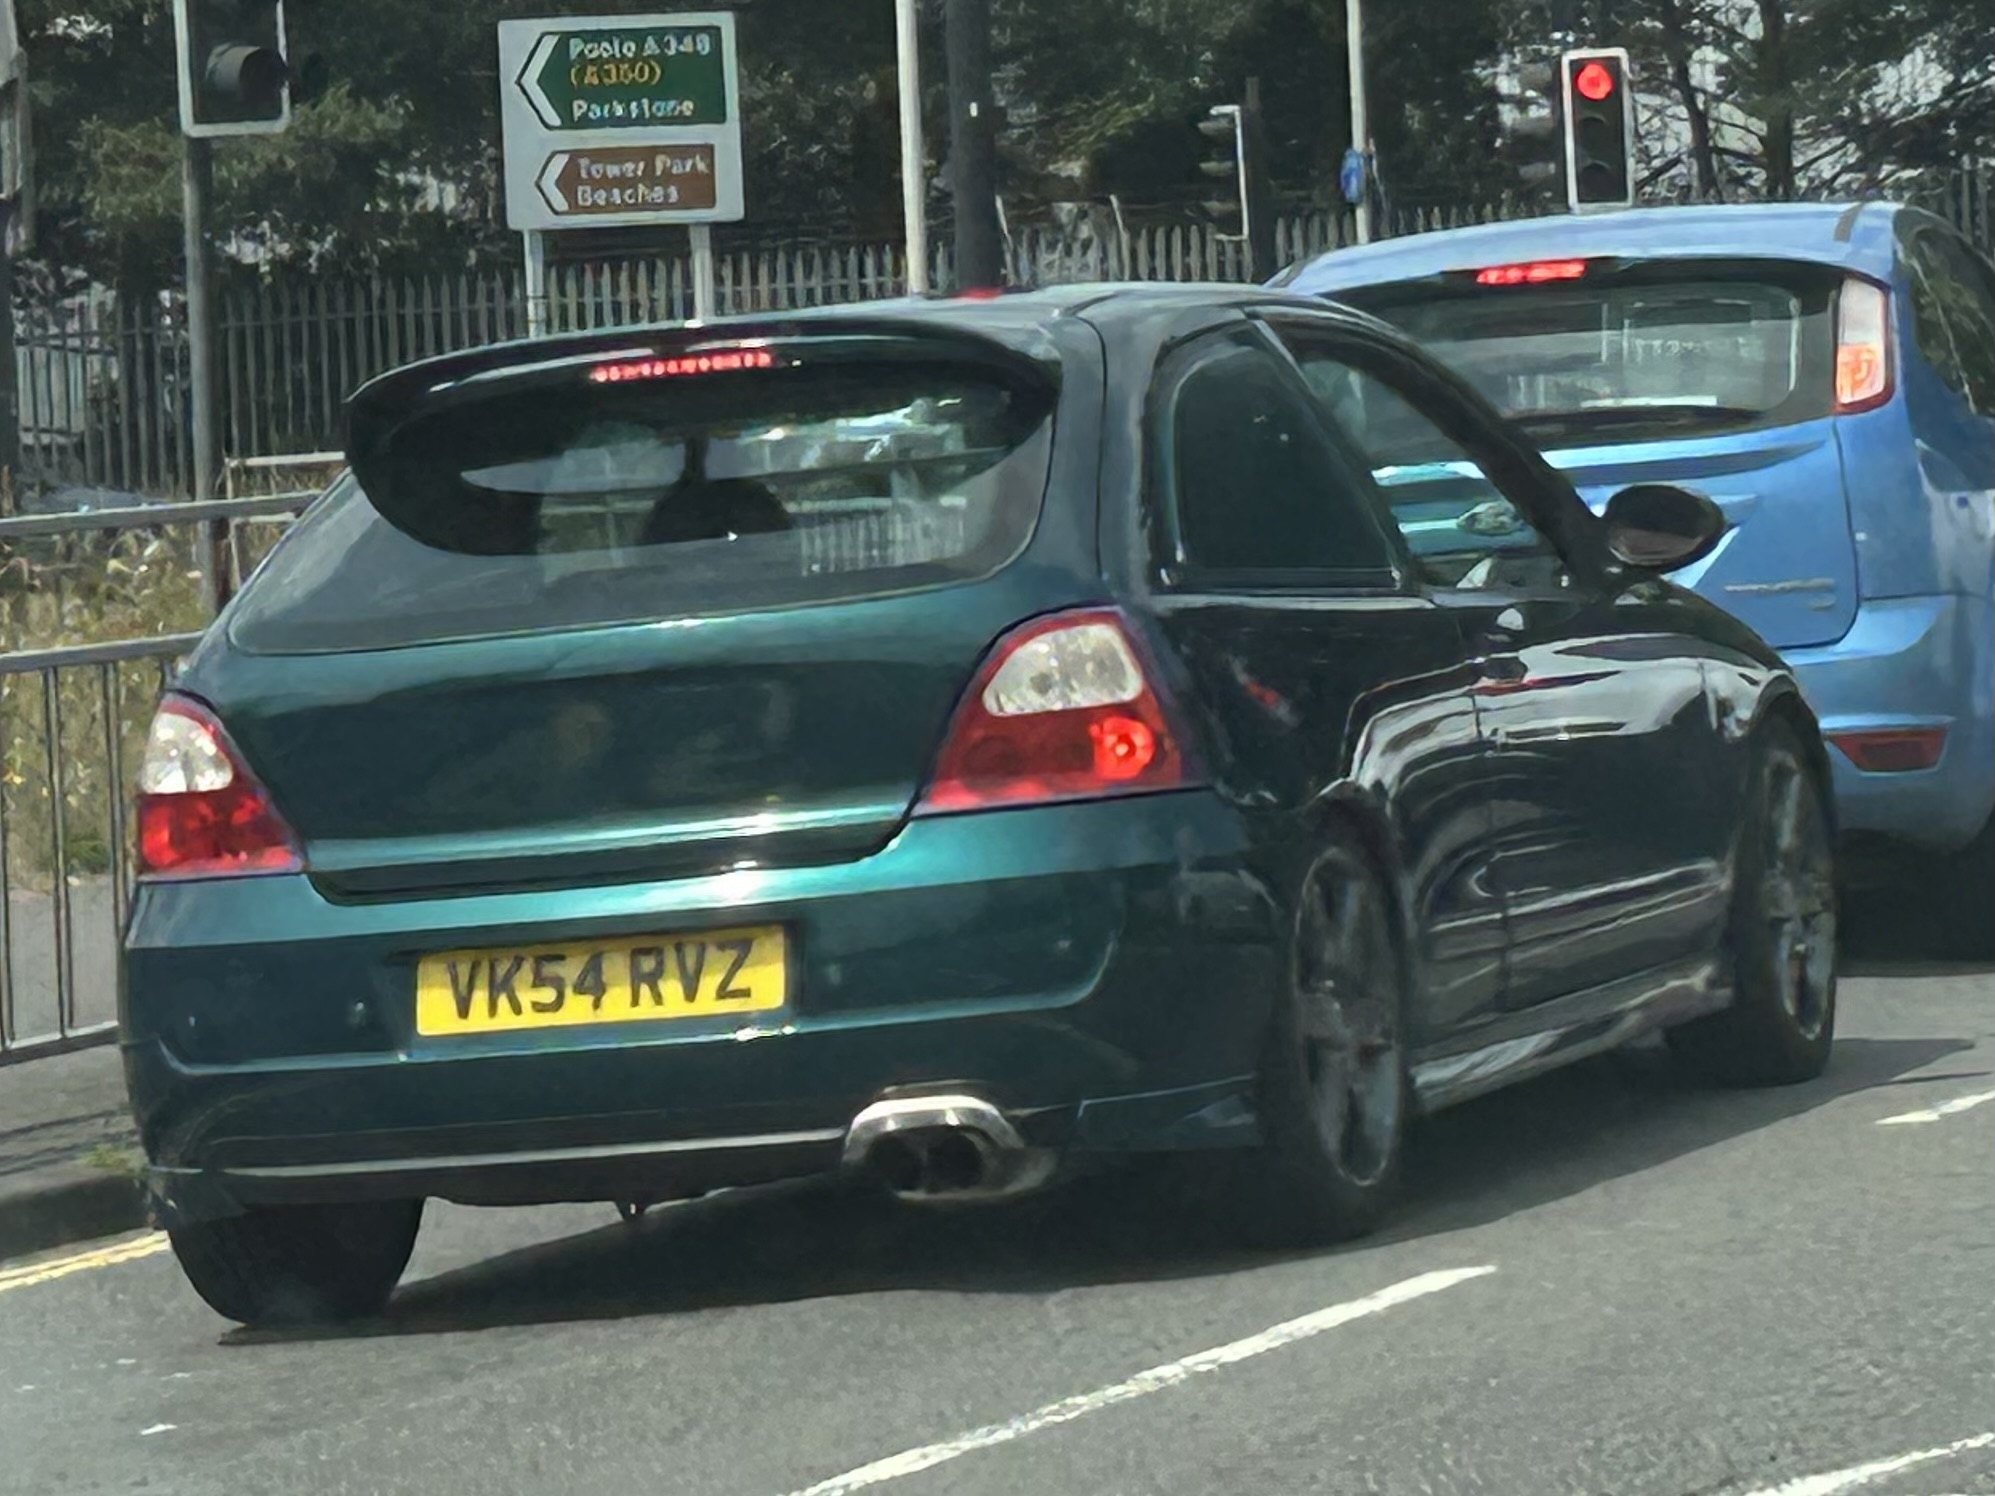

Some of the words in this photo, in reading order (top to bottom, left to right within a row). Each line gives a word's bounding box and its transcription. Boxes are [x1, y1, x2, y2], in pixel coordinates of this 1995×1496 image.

[569, 36, 636, 60] Poole
[577, 156, 645, 179] Tower
[654, 153, 710, 176] Park
[576, 183, 679, 207] Beaches
[447, 952, 607, 1020] VK54
[629, 938, 755, 1008] RVZ
